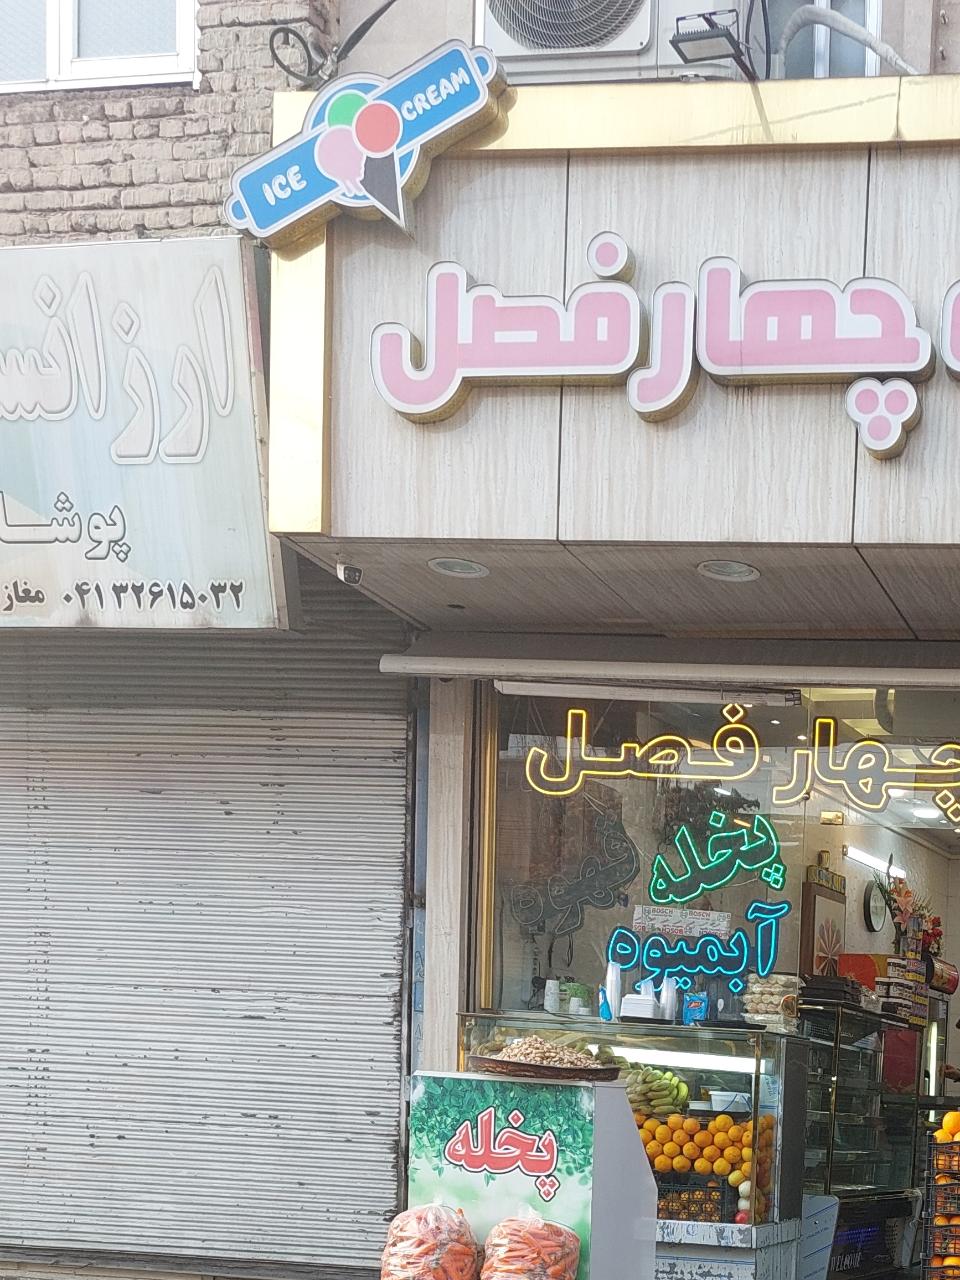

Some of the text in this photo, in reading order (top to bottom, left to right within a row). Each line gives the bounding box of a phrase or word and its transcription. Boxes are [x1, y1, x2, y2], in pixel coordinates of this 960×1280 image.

[262, 68, 472, 206] ICE CREAM
[371, 231, 640, 414] فصل
[627, 256, 932, 453] چهار
[526, 702, 760, 796] فصل
[608, 901, 790, 994] آبمیوه
[444, 1106, 559, 1202] پخله
